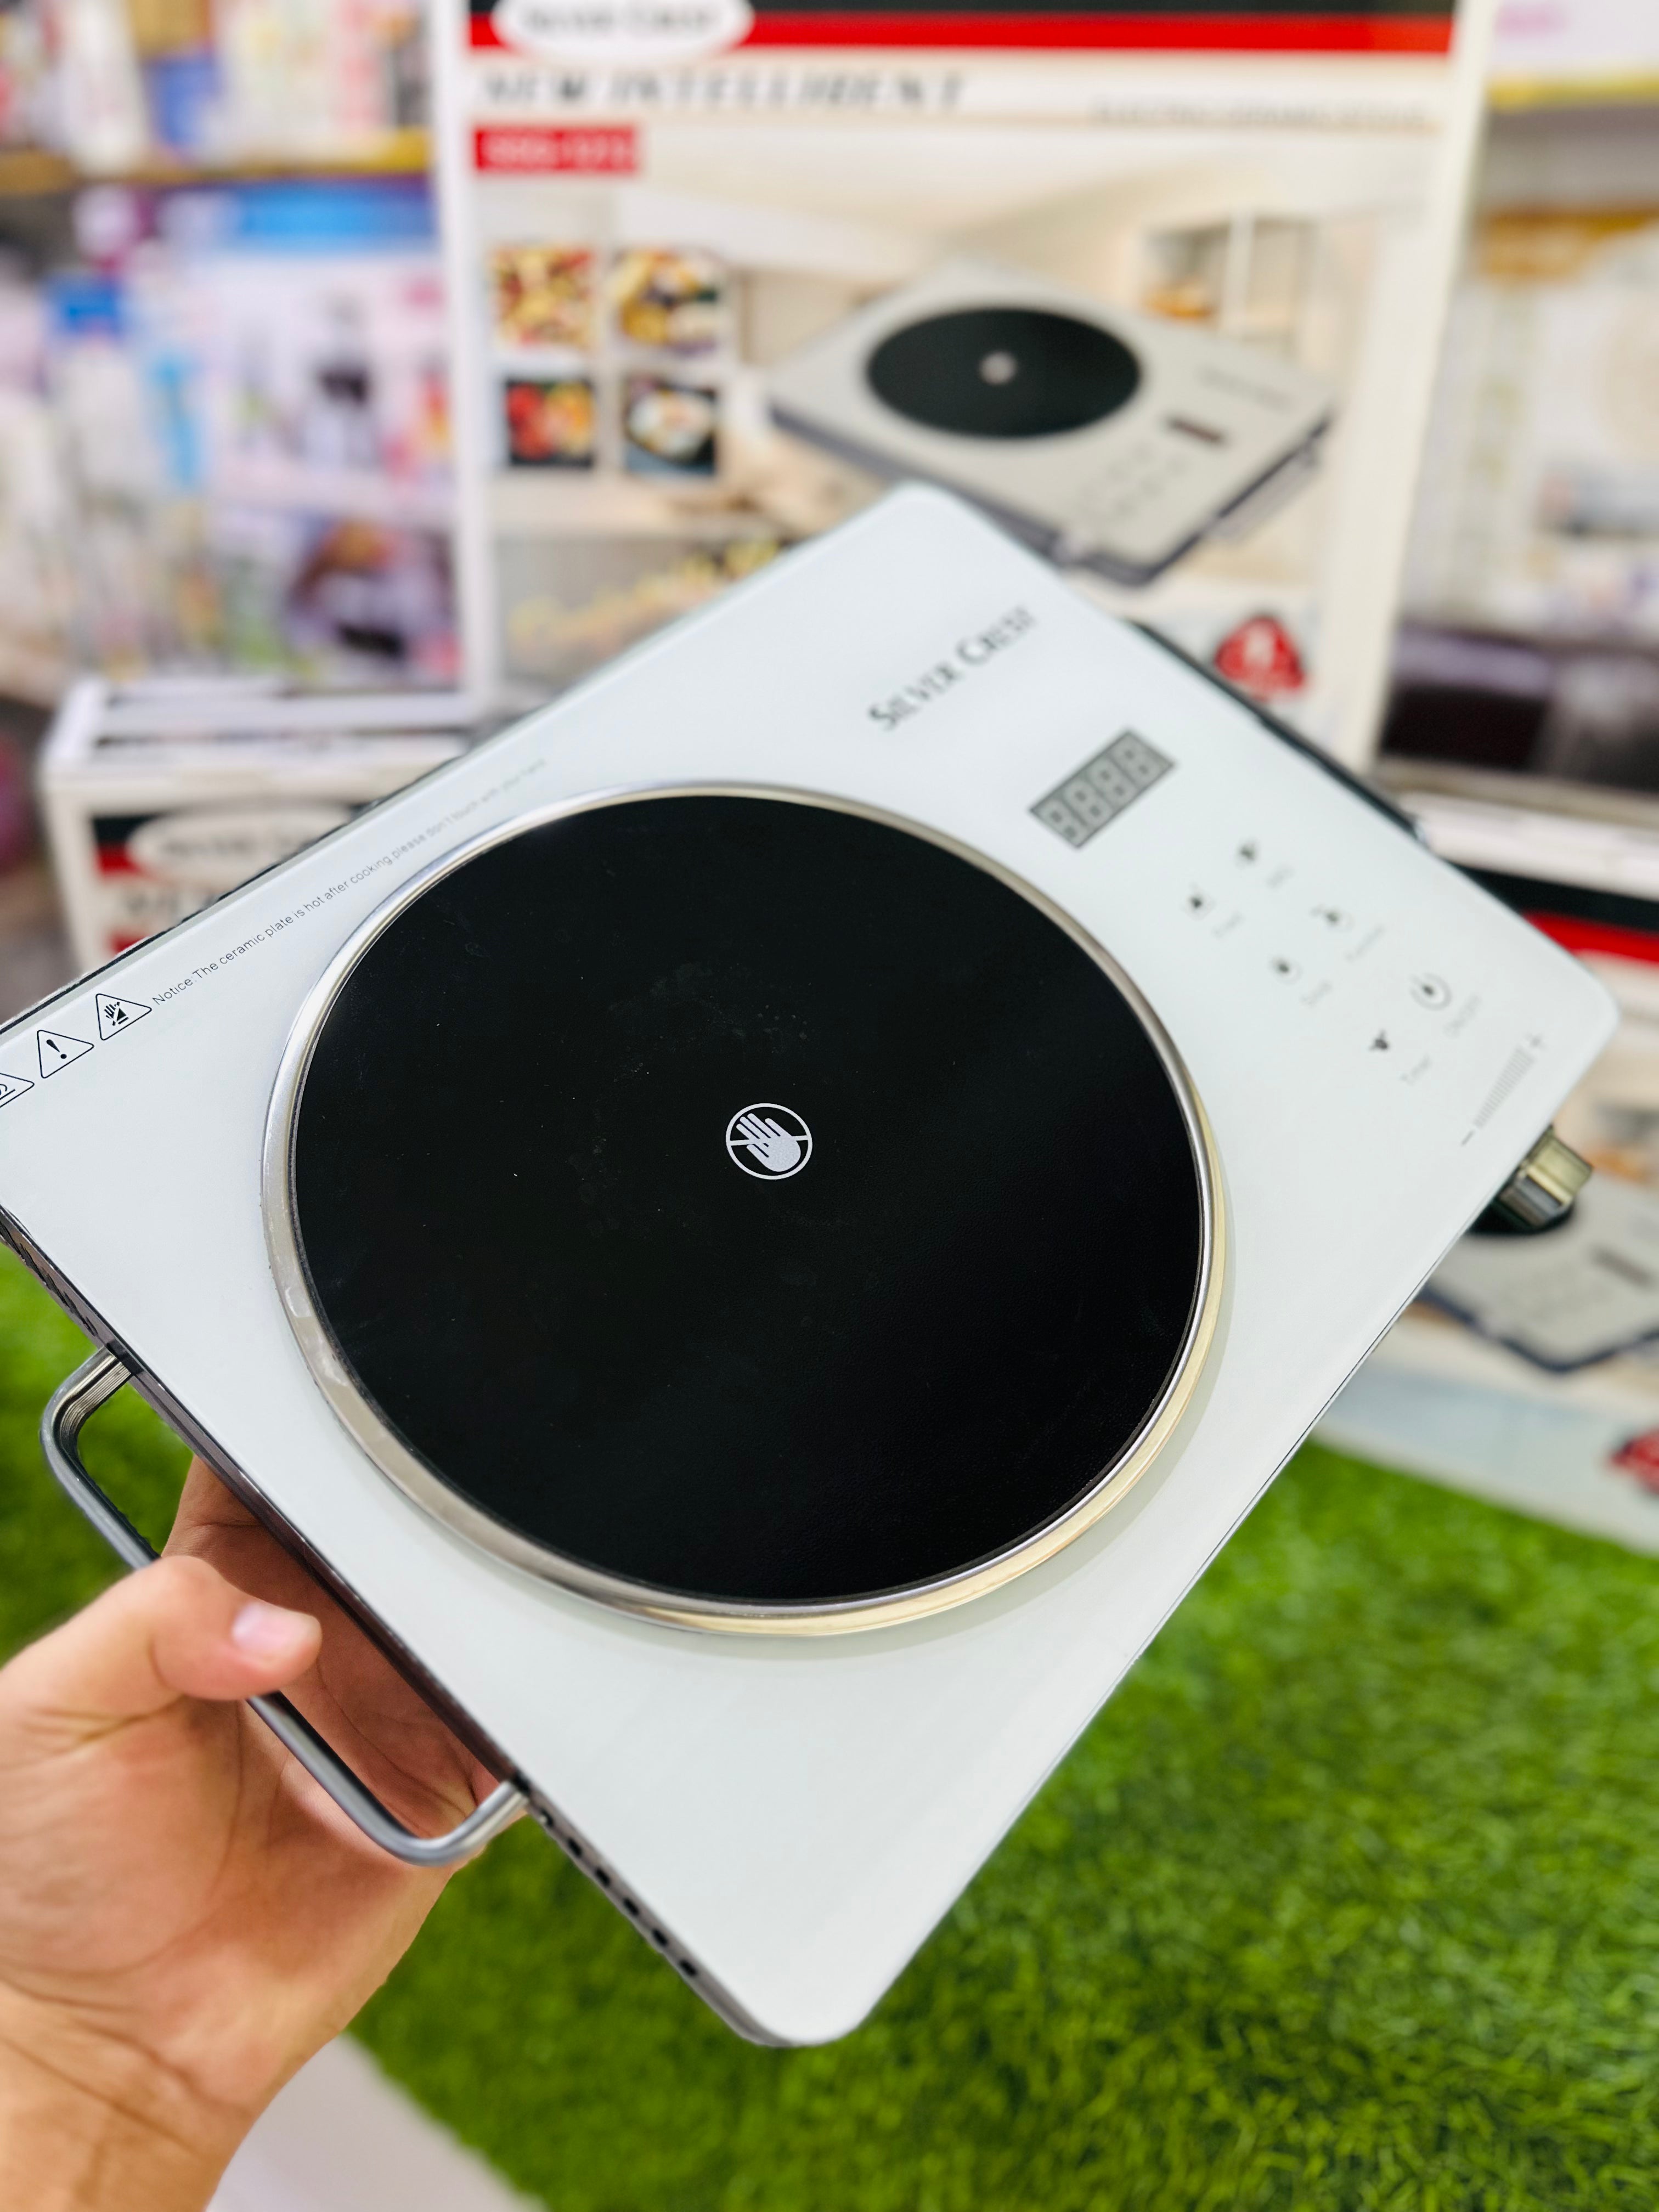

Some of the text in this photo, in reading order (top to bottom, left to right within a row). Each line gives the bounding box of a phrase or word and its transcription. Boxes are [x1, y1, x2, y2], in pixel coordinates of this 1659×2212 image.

[192, 963, 218, 978] The
[219, 934, 265, 964] ceramic
[264, 916, 294, 938] plate
[293, 909, 305, 919] is
[303, 896, 325, 912] hot
[324, 887, 349, 900] after
[351, 855, 393, 884] cooking
[392, 833, 426, 859] please
